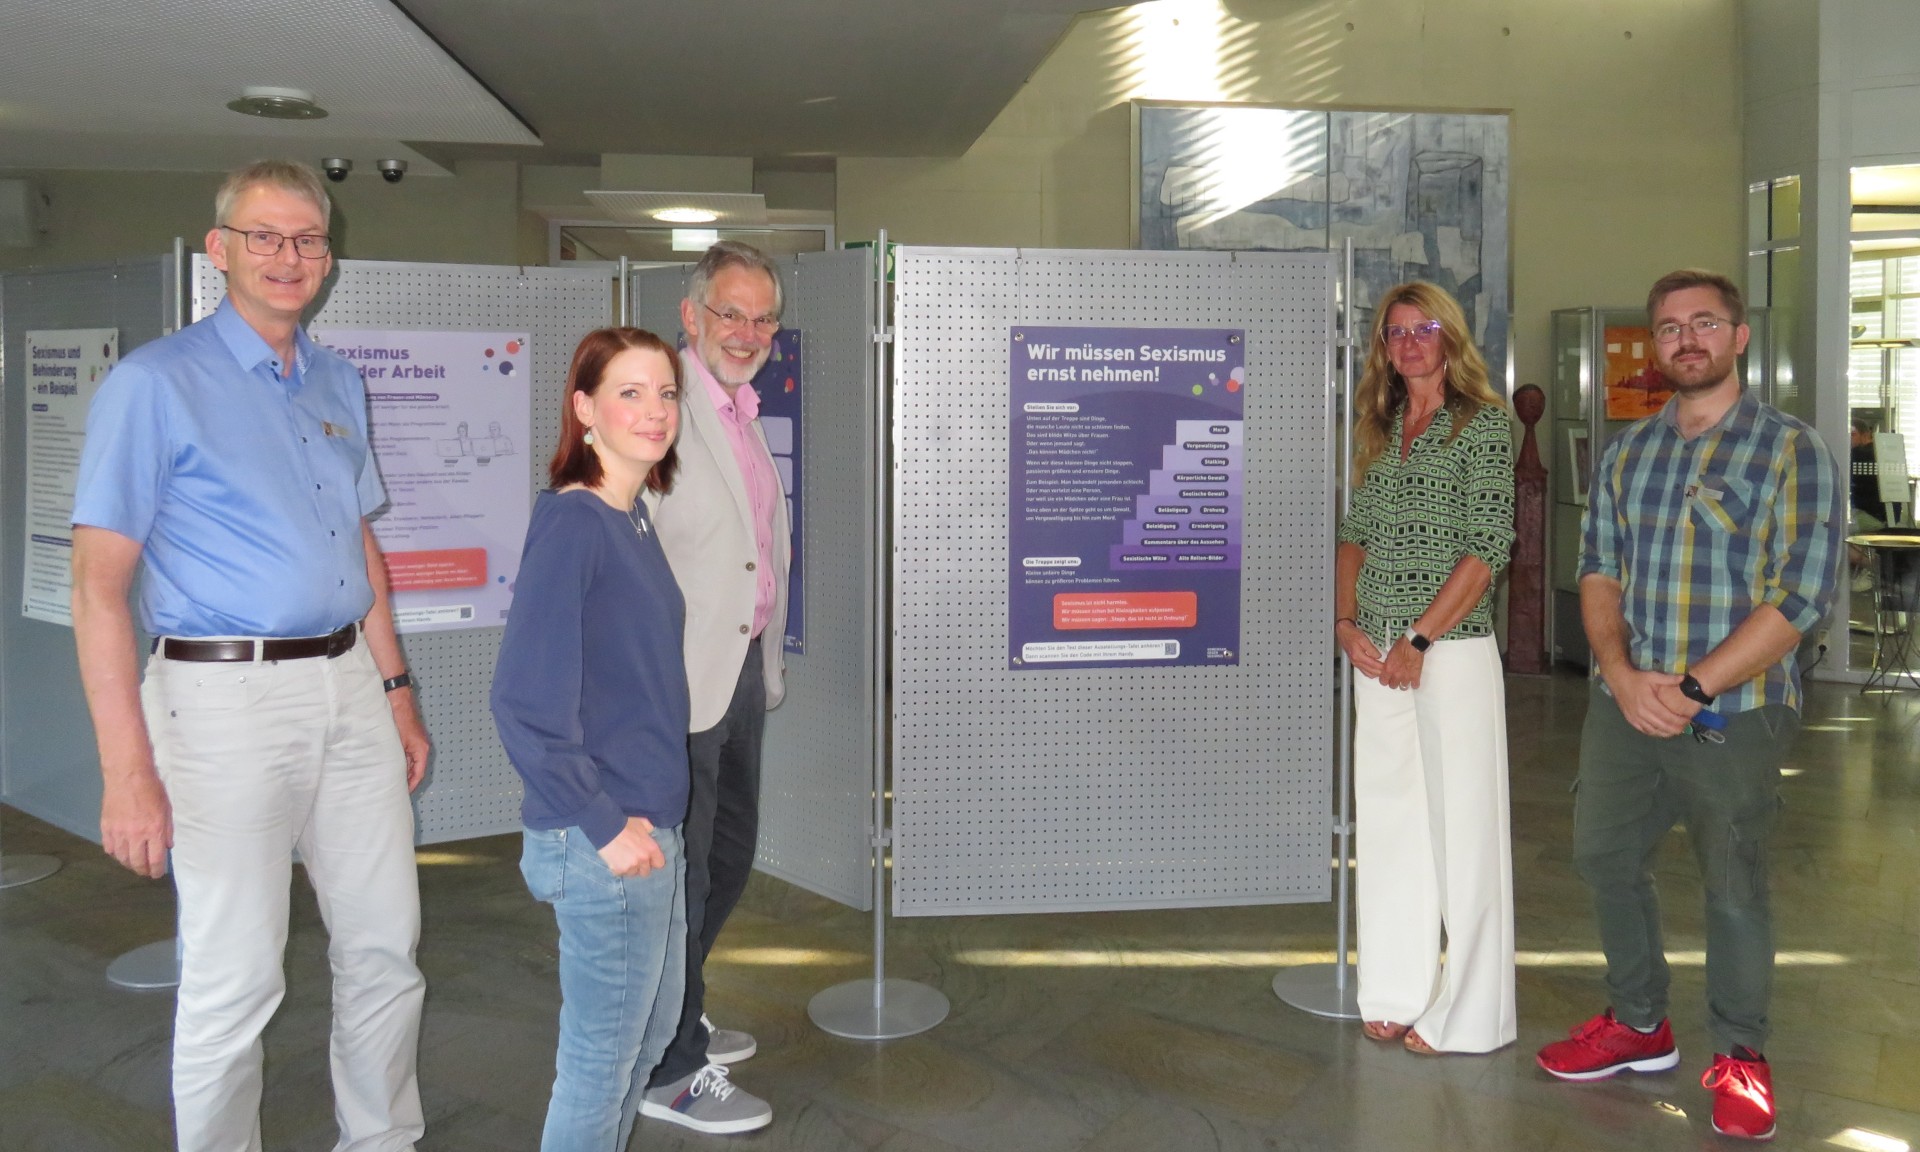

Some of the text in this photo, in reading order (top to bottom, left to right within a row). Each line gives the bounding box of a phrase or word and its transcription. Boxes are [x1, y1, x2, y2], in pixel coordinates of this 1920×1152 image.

[33, 346, 81, 358] Sexismus und
[325, 345, 410, 360] exismus
[1027, 344, 1226, 362] Wir müssen Sexismus
[33, 364, 76, 379] Behinderung
[392, 365, 445, 379] Arbeit
[1027, 366, 1160, 382] ernst nehmen!
[38, 382, 48, 394] ein
[50, 382, 78, 397] Beispiel
